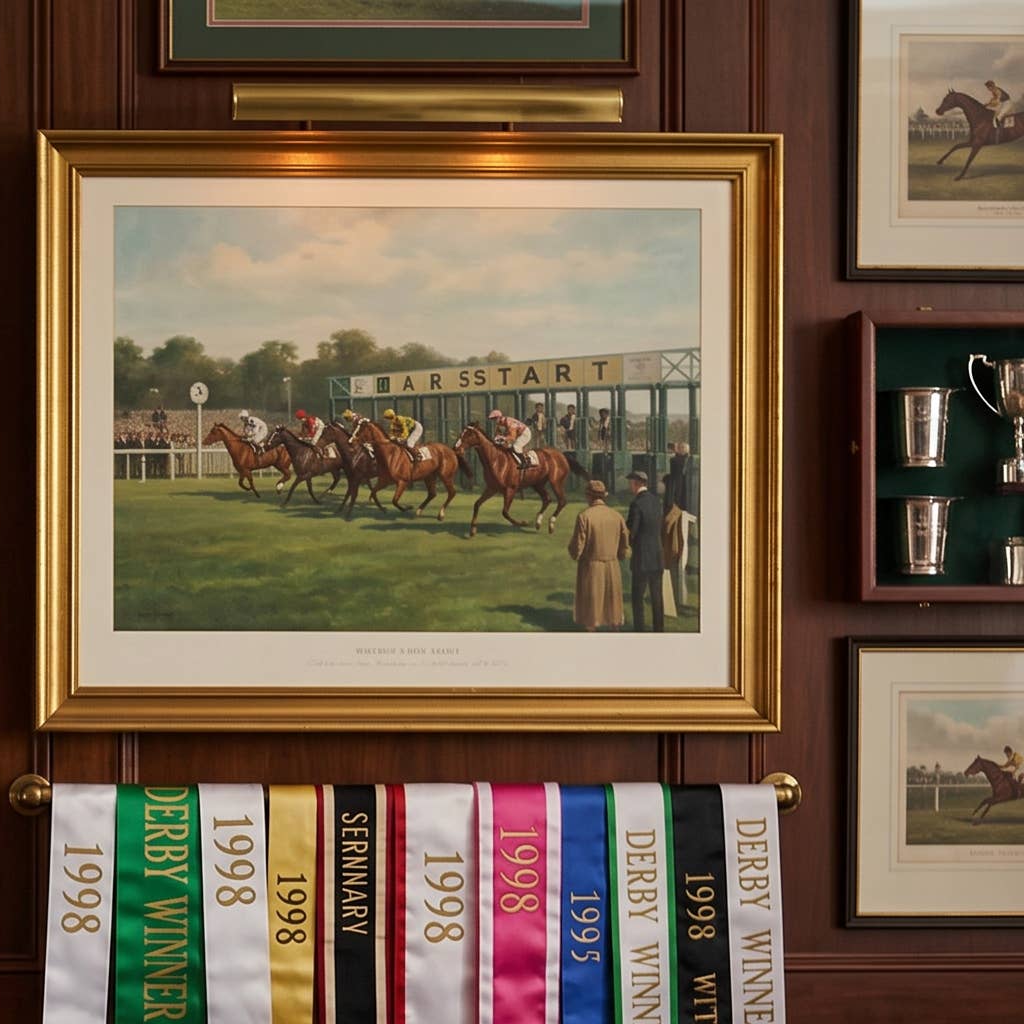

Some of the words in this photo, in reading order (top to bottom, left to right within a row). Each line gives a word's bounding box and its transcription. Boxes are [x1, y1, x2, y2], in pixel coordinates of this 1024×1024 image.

[144, 786, 189, 885] DERBY
[213, 814, 257, 907] 1998
[499, 825, 540, 914] 1998
[625, 828, 658, 924] DERBY
[736, 816, 771, 911] DERBY
[61, 842, 104, 934] 1998
[276, 872, 308, 945] 1998
[423, 851, 465, 944] 1998
[570, 890, 601, 963] 1995
[684, 872, 717, 942] 1998
[144, 894, 189, 1022] WINNER
